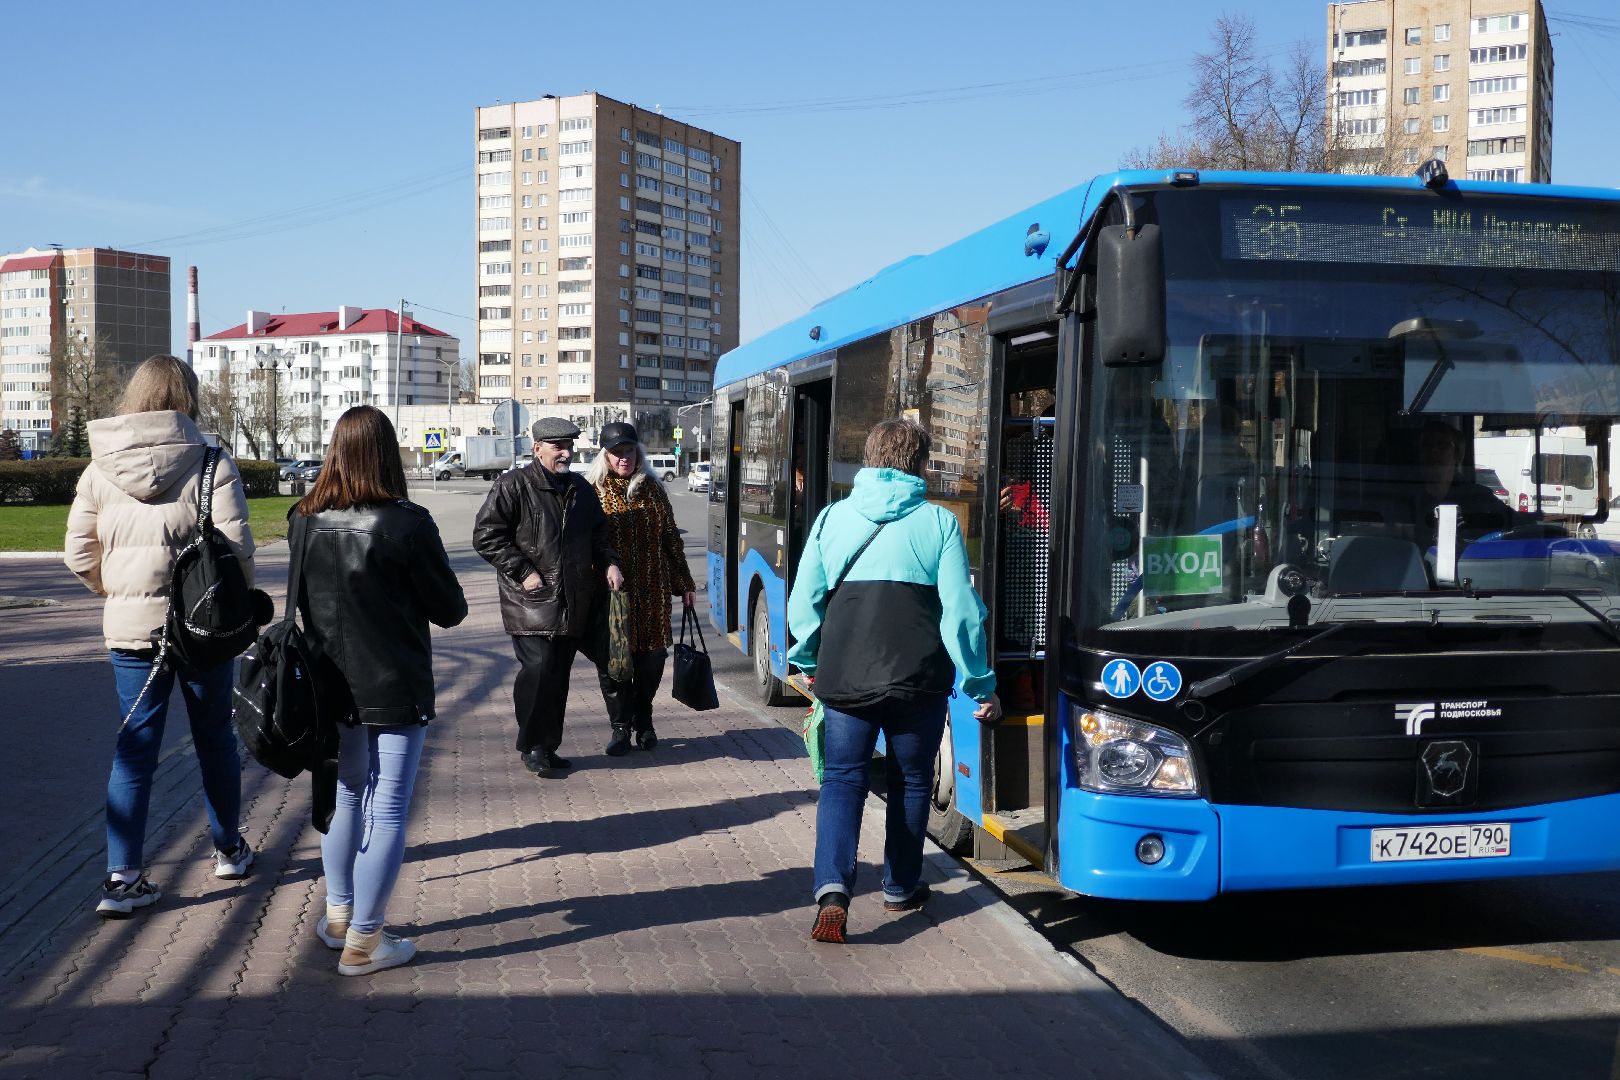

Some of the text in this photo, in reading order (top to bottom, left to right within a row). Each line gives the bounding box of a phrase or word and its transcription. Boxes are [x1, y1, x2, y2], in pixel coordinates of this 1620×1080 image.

[1251, 204, 1301, 260] 35
[1147, 551, 1221, 578] ВХОД
[1440, 701, 1488, 710] ТРАНСПОРТ
[1440, 709, 1502, 719] ПОДМОСКОВЬЯ
[1472, 827, 1504, 847] 790
